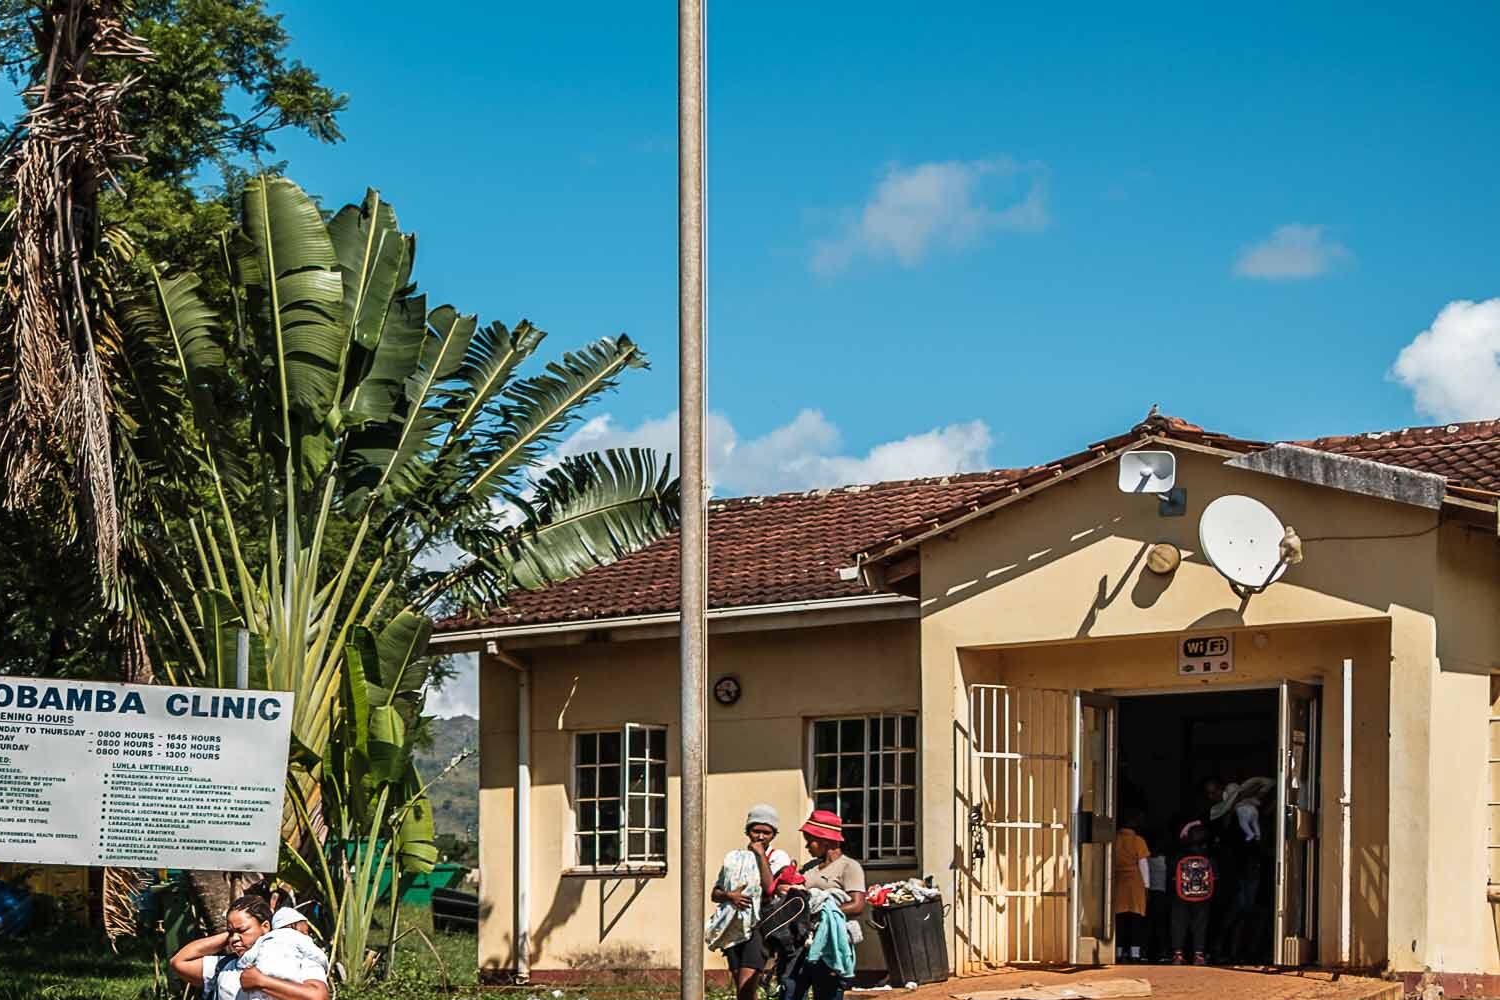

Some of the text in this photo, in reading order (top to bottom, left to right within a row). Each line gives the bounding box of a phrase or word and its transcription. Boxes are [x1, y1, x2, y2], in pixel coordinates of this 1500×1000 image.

[165, 692, 281, 721] CLINIC
[37, 714, 74, 723] HOURS
[39, 727, 85, 736] THURSDAY
[97, 730, 120, 738] 0800
[124, 731, 154, 739] HOURS
[191, 734, 220, 742] HOURS
[96, 738, 120, 747] 0800
[123, 740, 153, 748] HOURS
[190, 743, 220, 751] HOURS
[95, 747, 119, 755] 0800
[122, 749, 153, 757] HOURS
[189, 752, 219, 760] HOURS
